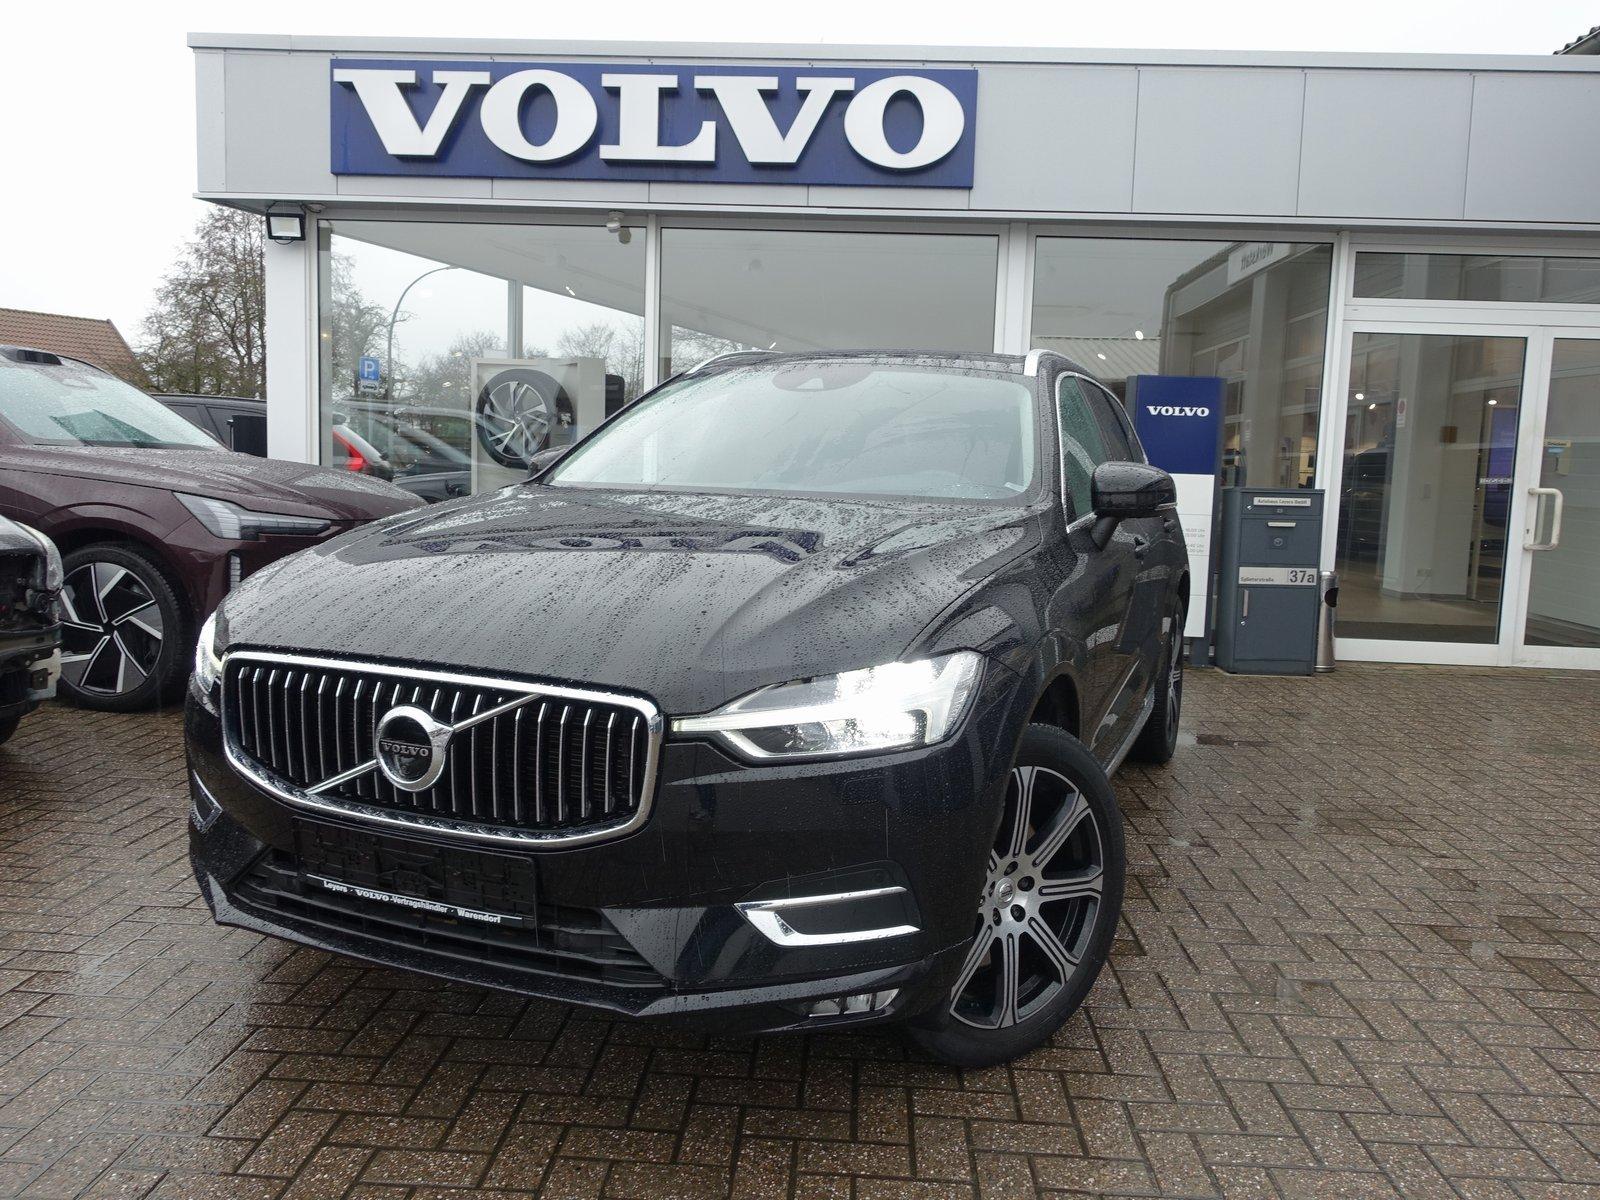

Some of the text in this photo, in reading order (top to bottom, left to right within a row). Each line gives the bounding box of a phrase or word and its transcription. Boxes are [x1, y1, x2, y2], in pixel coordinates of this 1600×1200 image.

[332, 68, 966, 170] VOLVO
[364, 360, 375, 378] P
[1146, 405, 1210, 417] VOLVO
[1289, 570, 1315, 584] 37a
[381, 742, 429, 757] VOLVO
[323, 880, 348, 893] Leyers
[356, 889, 390, 902] VOLVO
[457, 908, 501, 924] Warendorf
